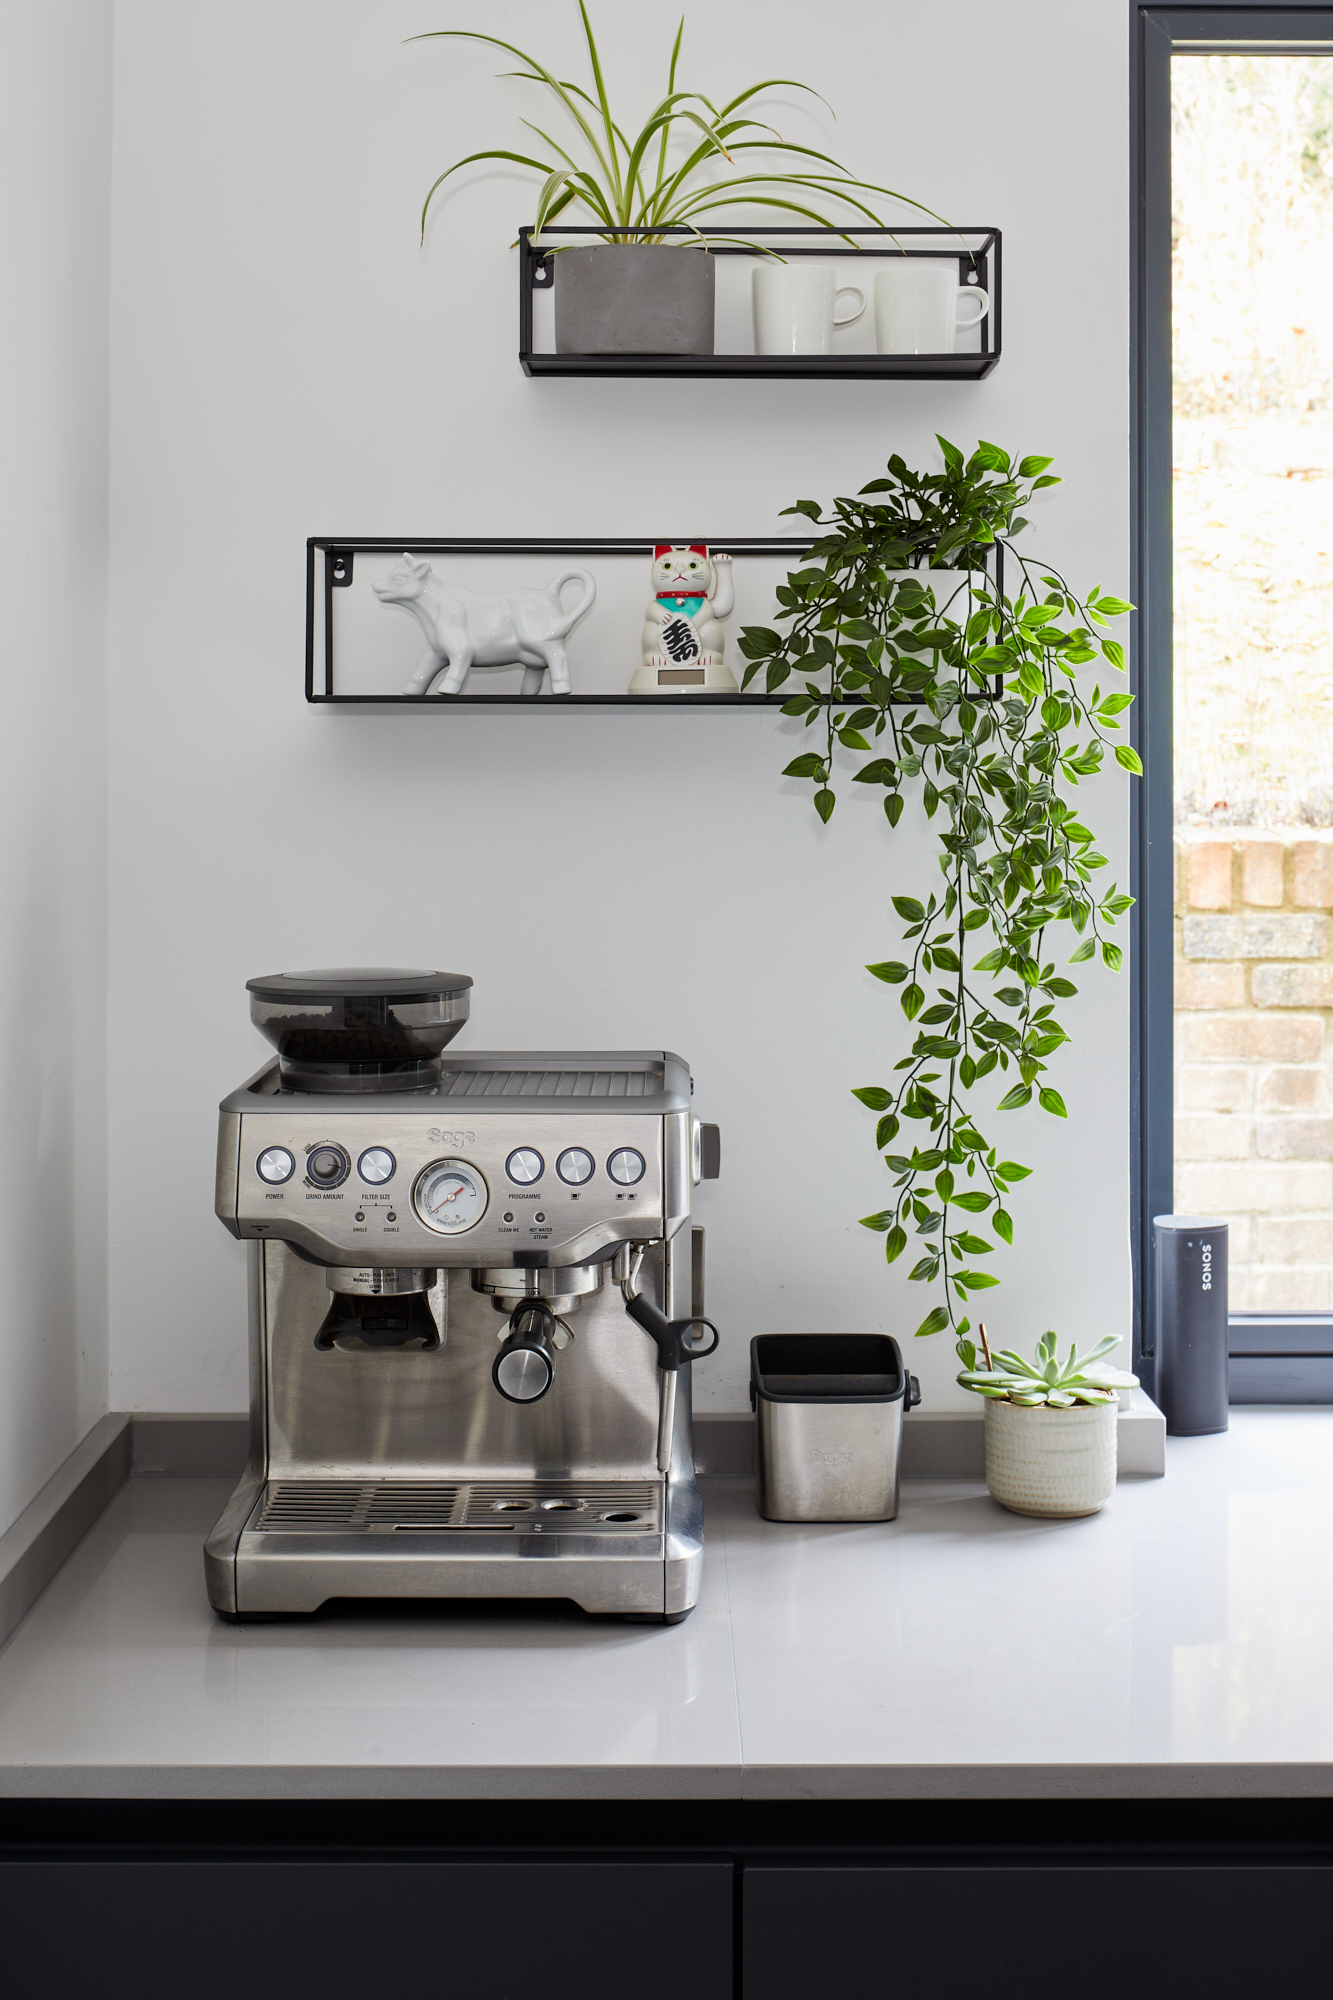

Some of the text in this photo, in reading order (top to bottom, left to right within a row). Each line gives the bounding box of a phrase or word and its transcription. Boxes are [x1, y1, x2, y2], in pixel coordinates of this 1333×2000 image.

[428, 1128, 475, 1149] Sage
[1202, 1244, 1212, 1291] SONOS
[809, 1448, 854, 1468] Sage
